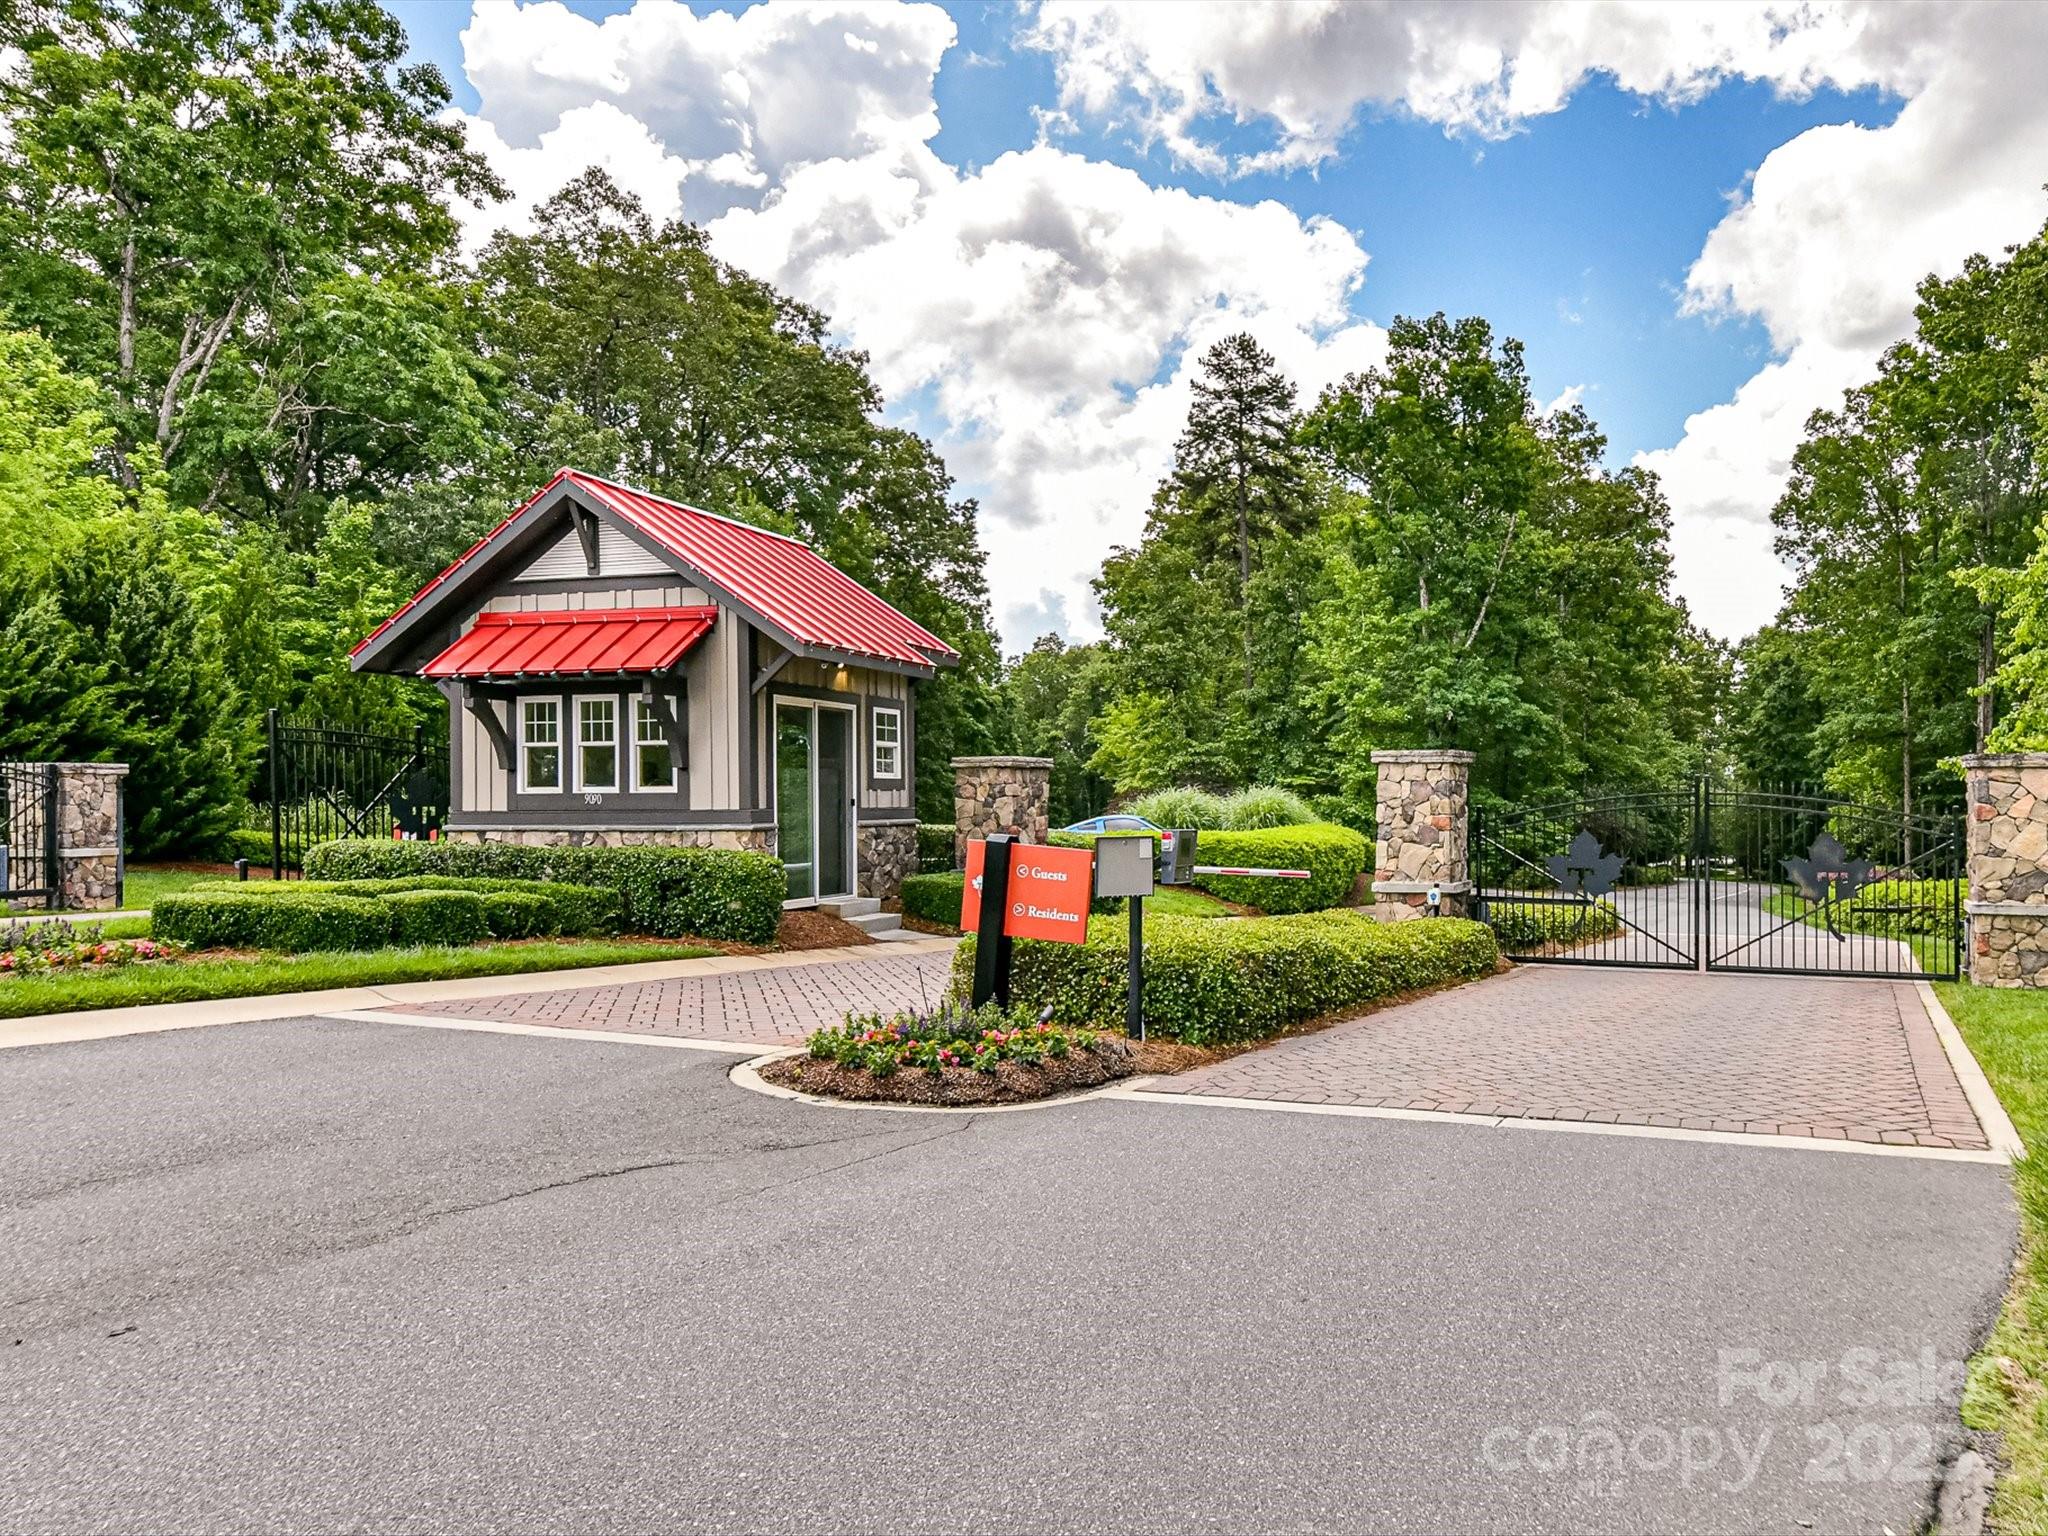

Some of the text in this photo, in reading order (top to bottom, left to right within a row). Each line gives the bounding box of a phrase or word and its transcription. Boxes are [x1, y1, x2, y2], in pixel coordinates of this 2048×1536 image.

[584, 793, 602, 805] 9090
[1031, 866, 1067, 882] Guests
[1028, 905, 1079, 922] Residents
